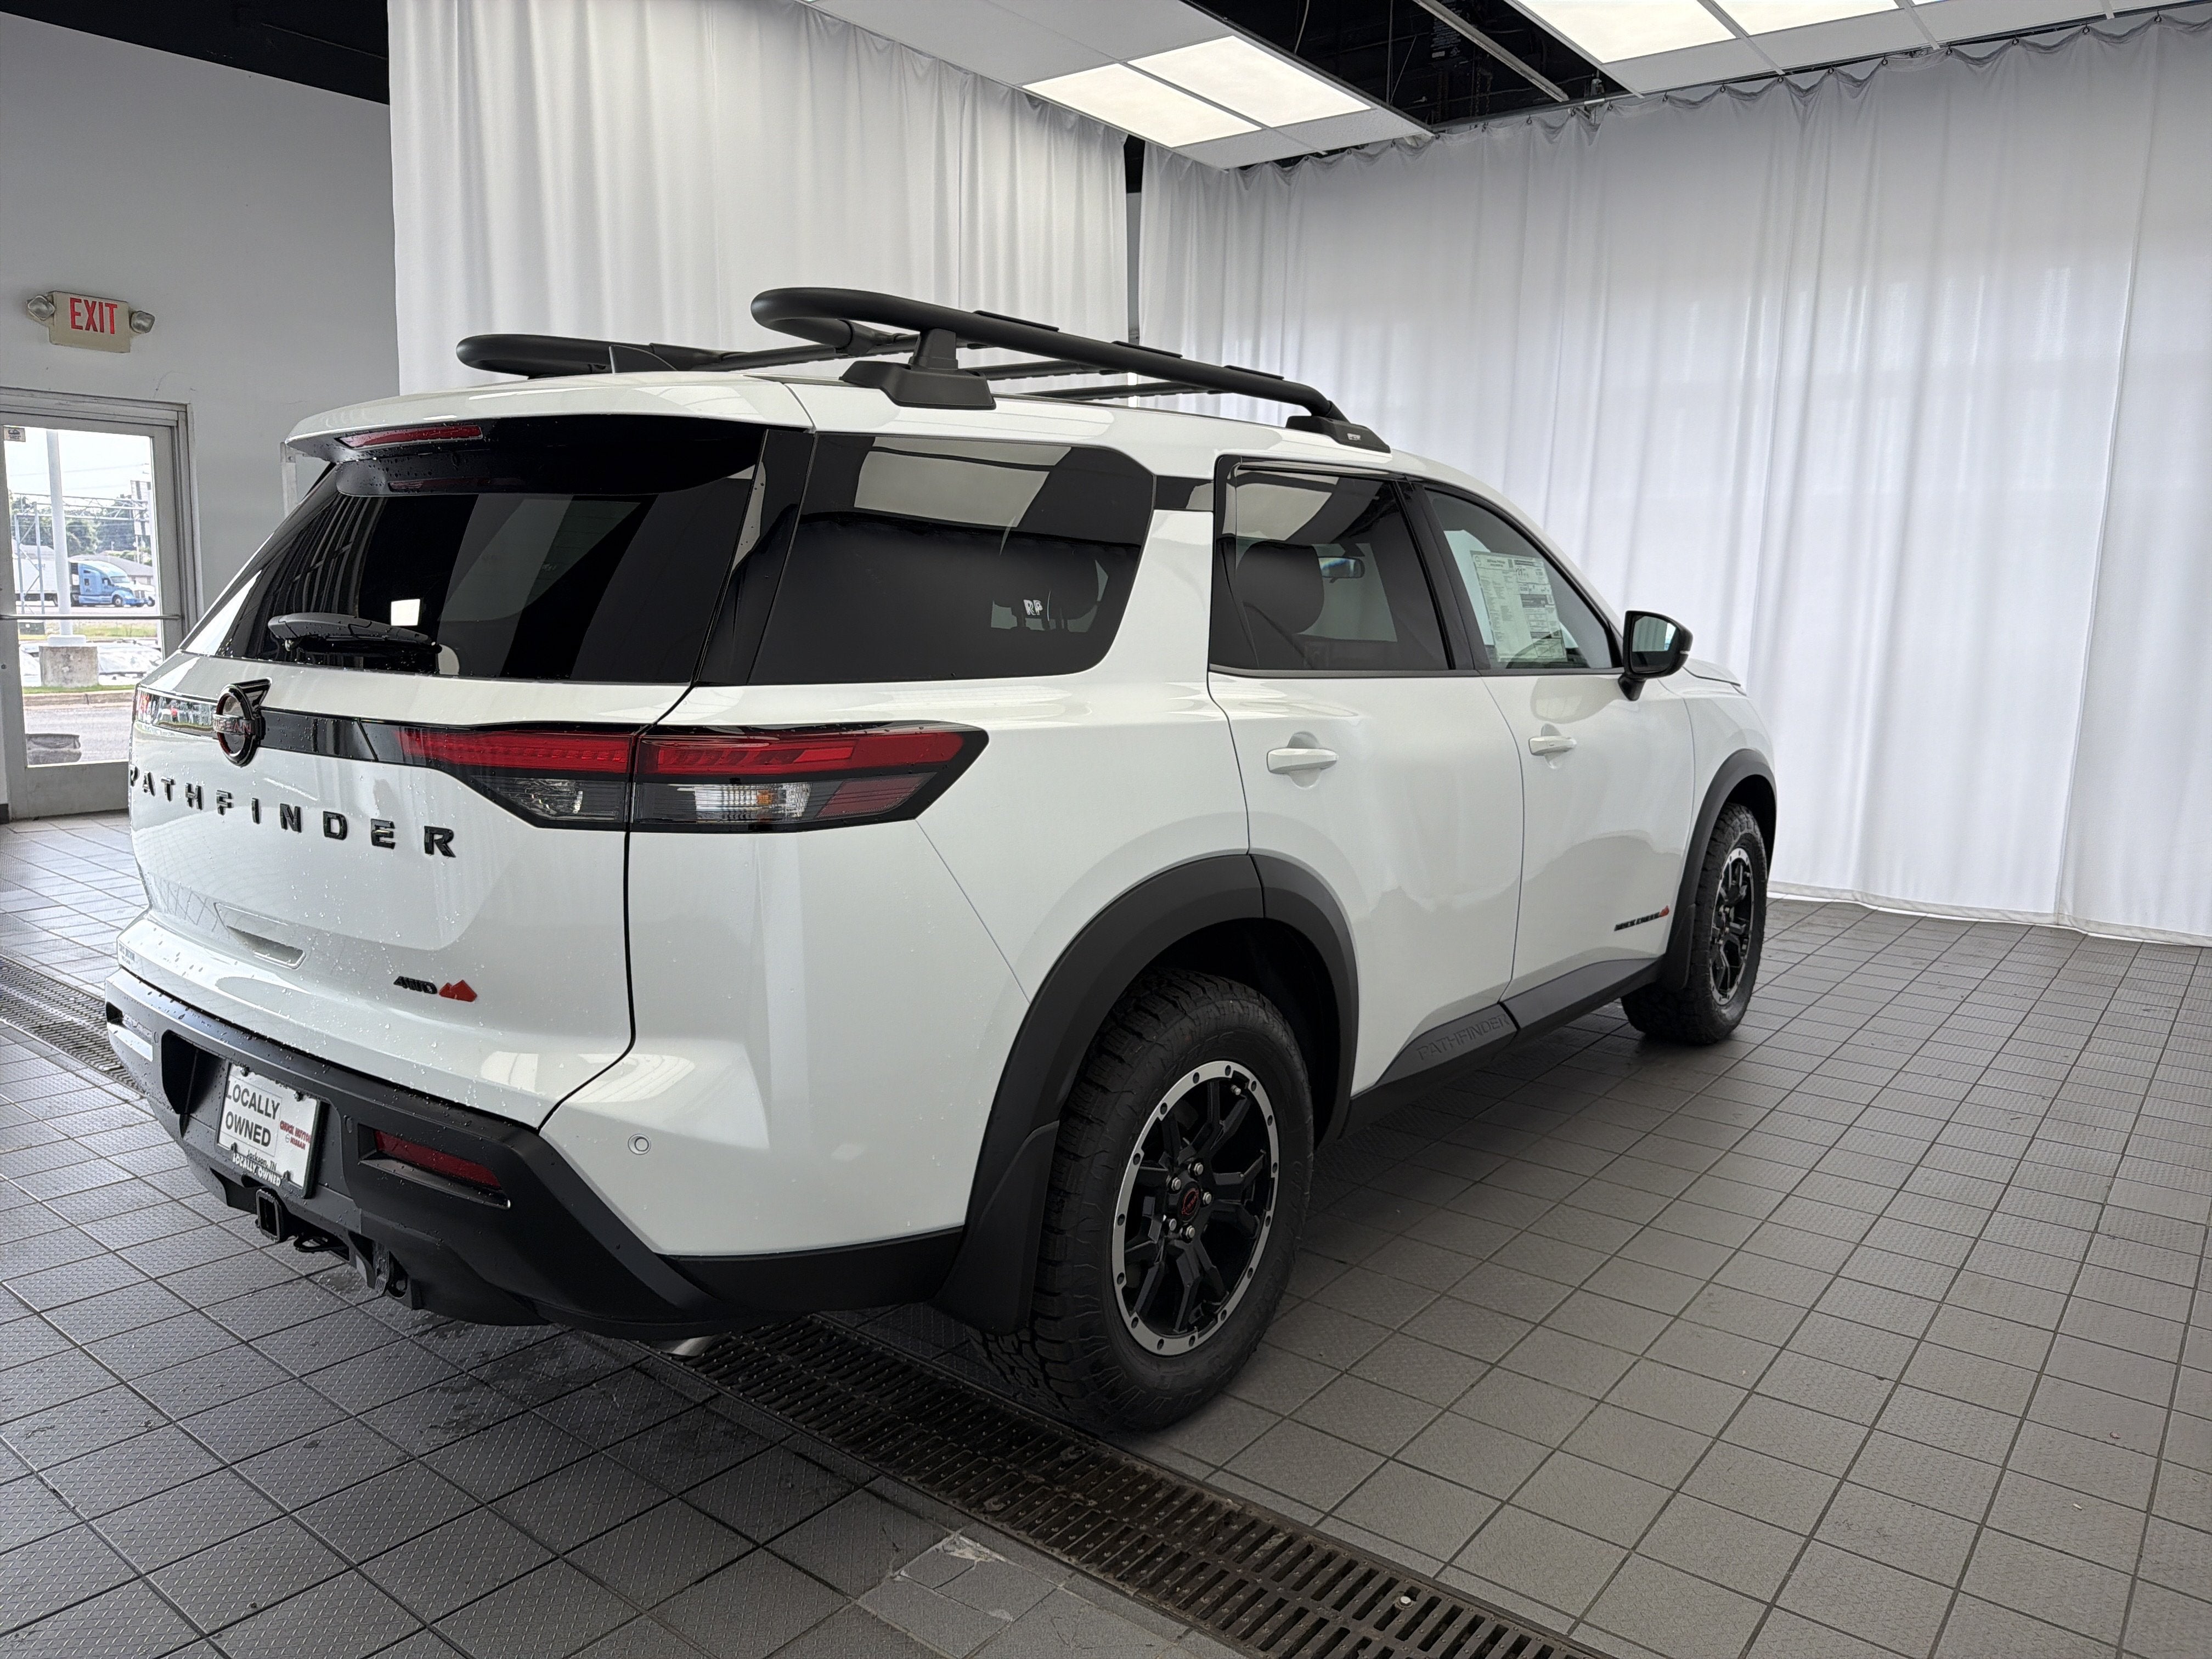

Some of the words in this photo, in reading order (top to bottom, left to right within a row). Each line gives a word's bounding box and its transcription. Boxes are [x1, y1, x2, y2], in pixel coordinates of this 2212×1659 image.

[70, 297, 118, 335] EXIT
[129, 764, 456, 858] PATHFINDER
[393, 976, 437, 994] 4WD
[1417, 1013, 1510, 1060] PATHFINDER
[225, 1081, 280, 1120] LOCALLY
[225, 1111, 271, 1147] OWNED
